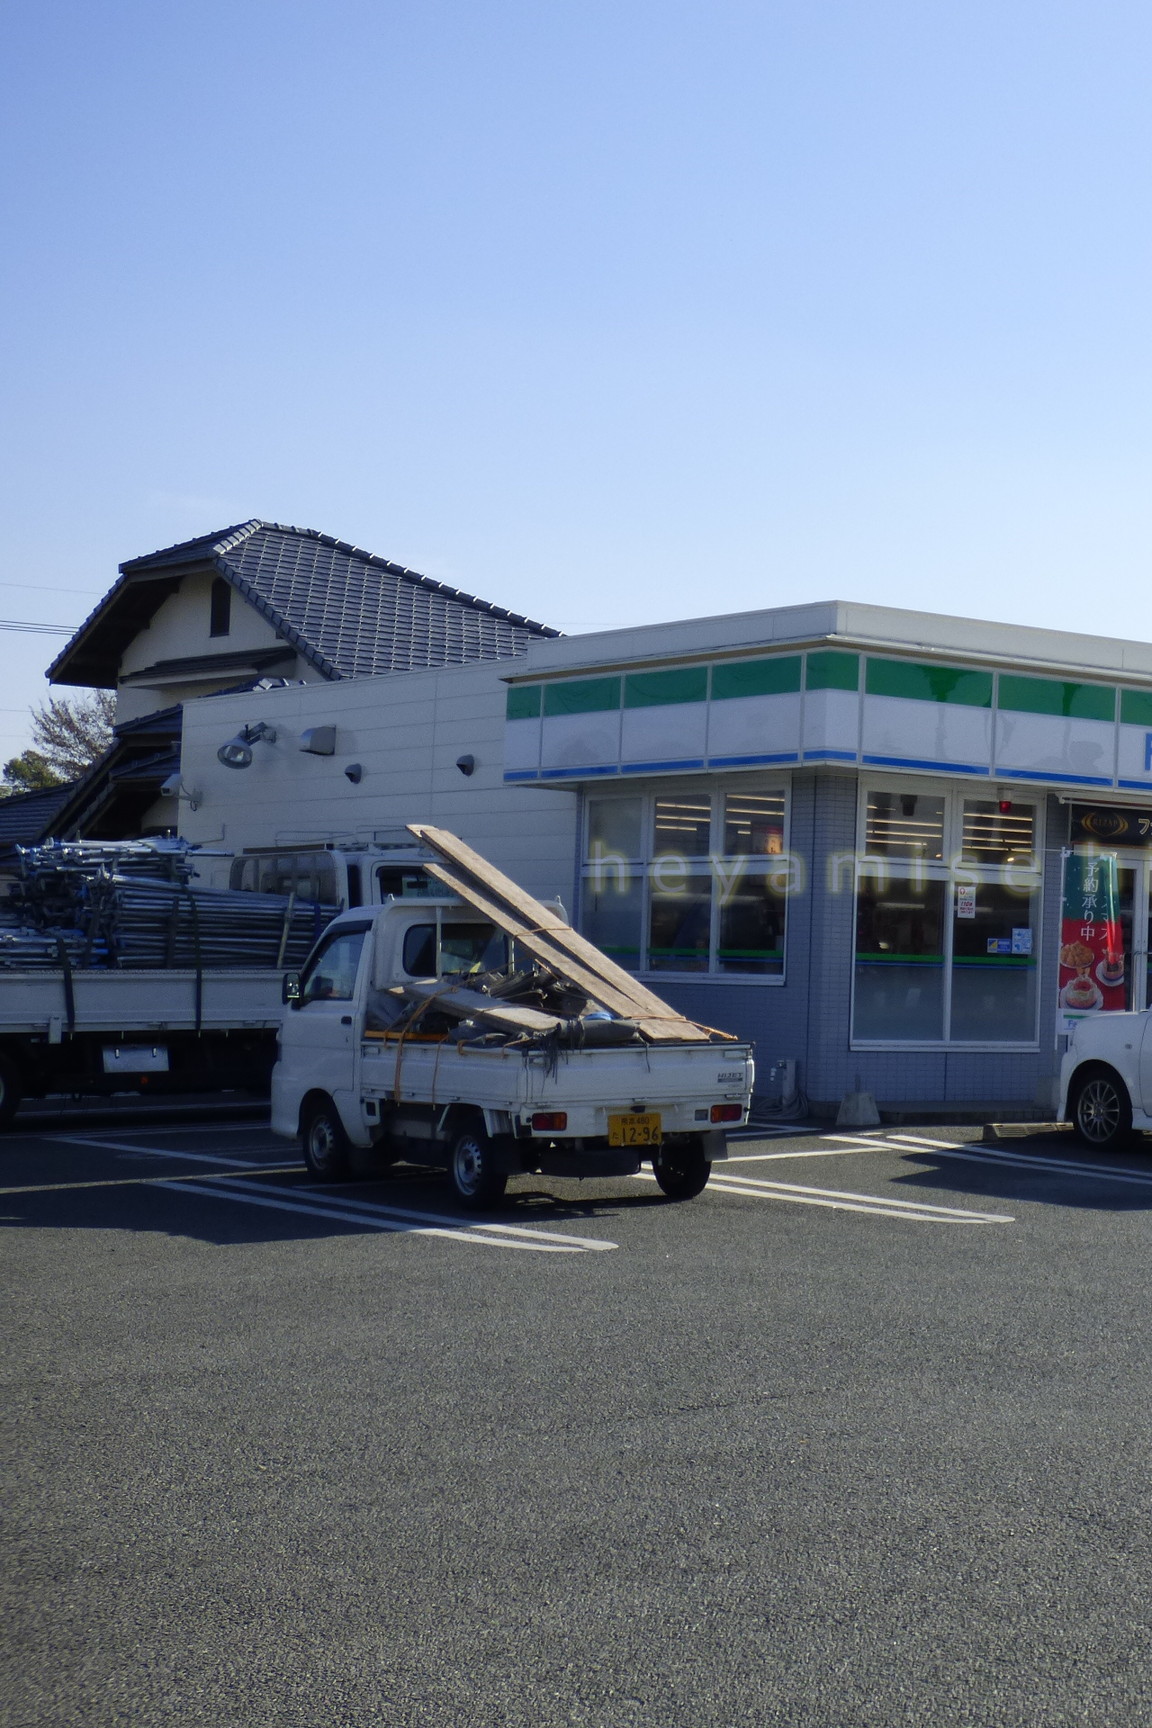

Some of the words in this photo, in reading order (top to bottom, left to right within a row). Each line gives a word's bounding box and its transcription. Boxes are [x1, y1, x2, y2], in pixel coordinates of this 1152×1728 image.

[1081, 861, 1100, 941] 予約承り中
[622, 1126, 659, 1143] 12-96
